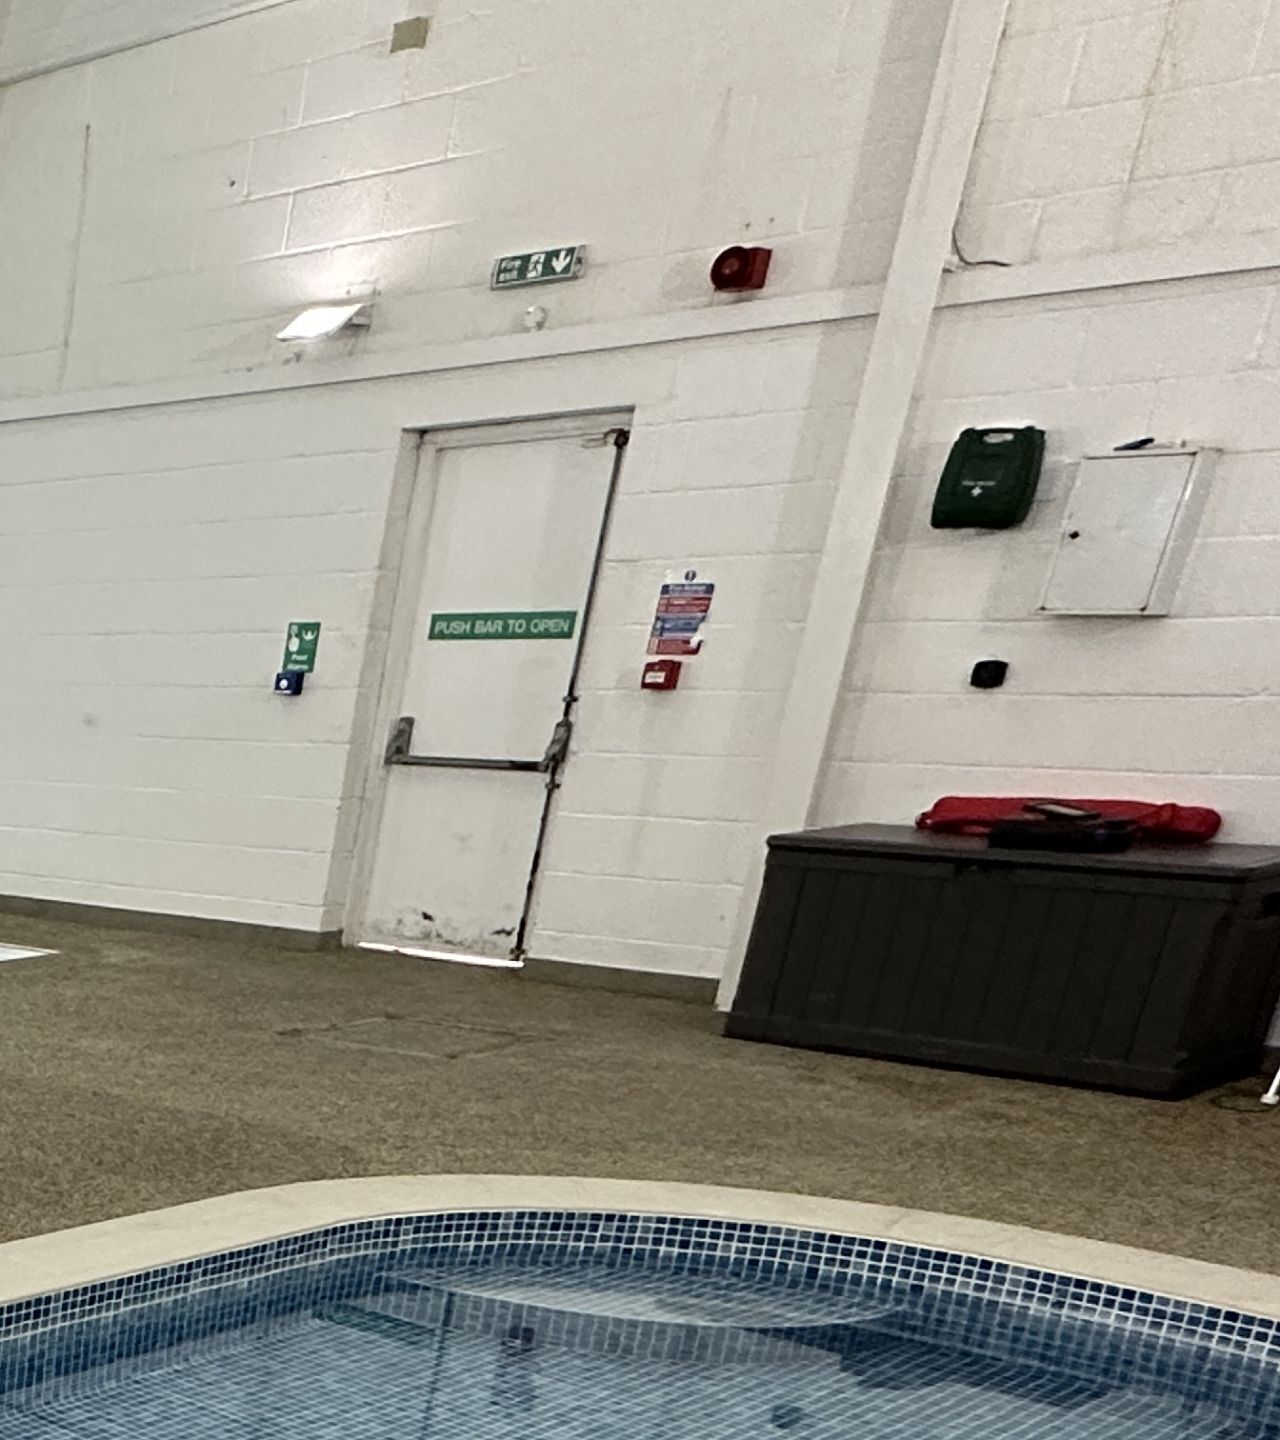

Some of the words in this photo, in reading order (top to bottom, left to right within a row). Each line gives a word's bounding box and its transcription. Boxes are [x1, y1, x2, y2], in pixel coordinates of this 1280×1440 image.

[434, 620, 471, 635] PUSH
[474, 619, 504, 634] BAR
[507, 619, 526, 633] TO
[530, 618, 570, 633] OPEN
